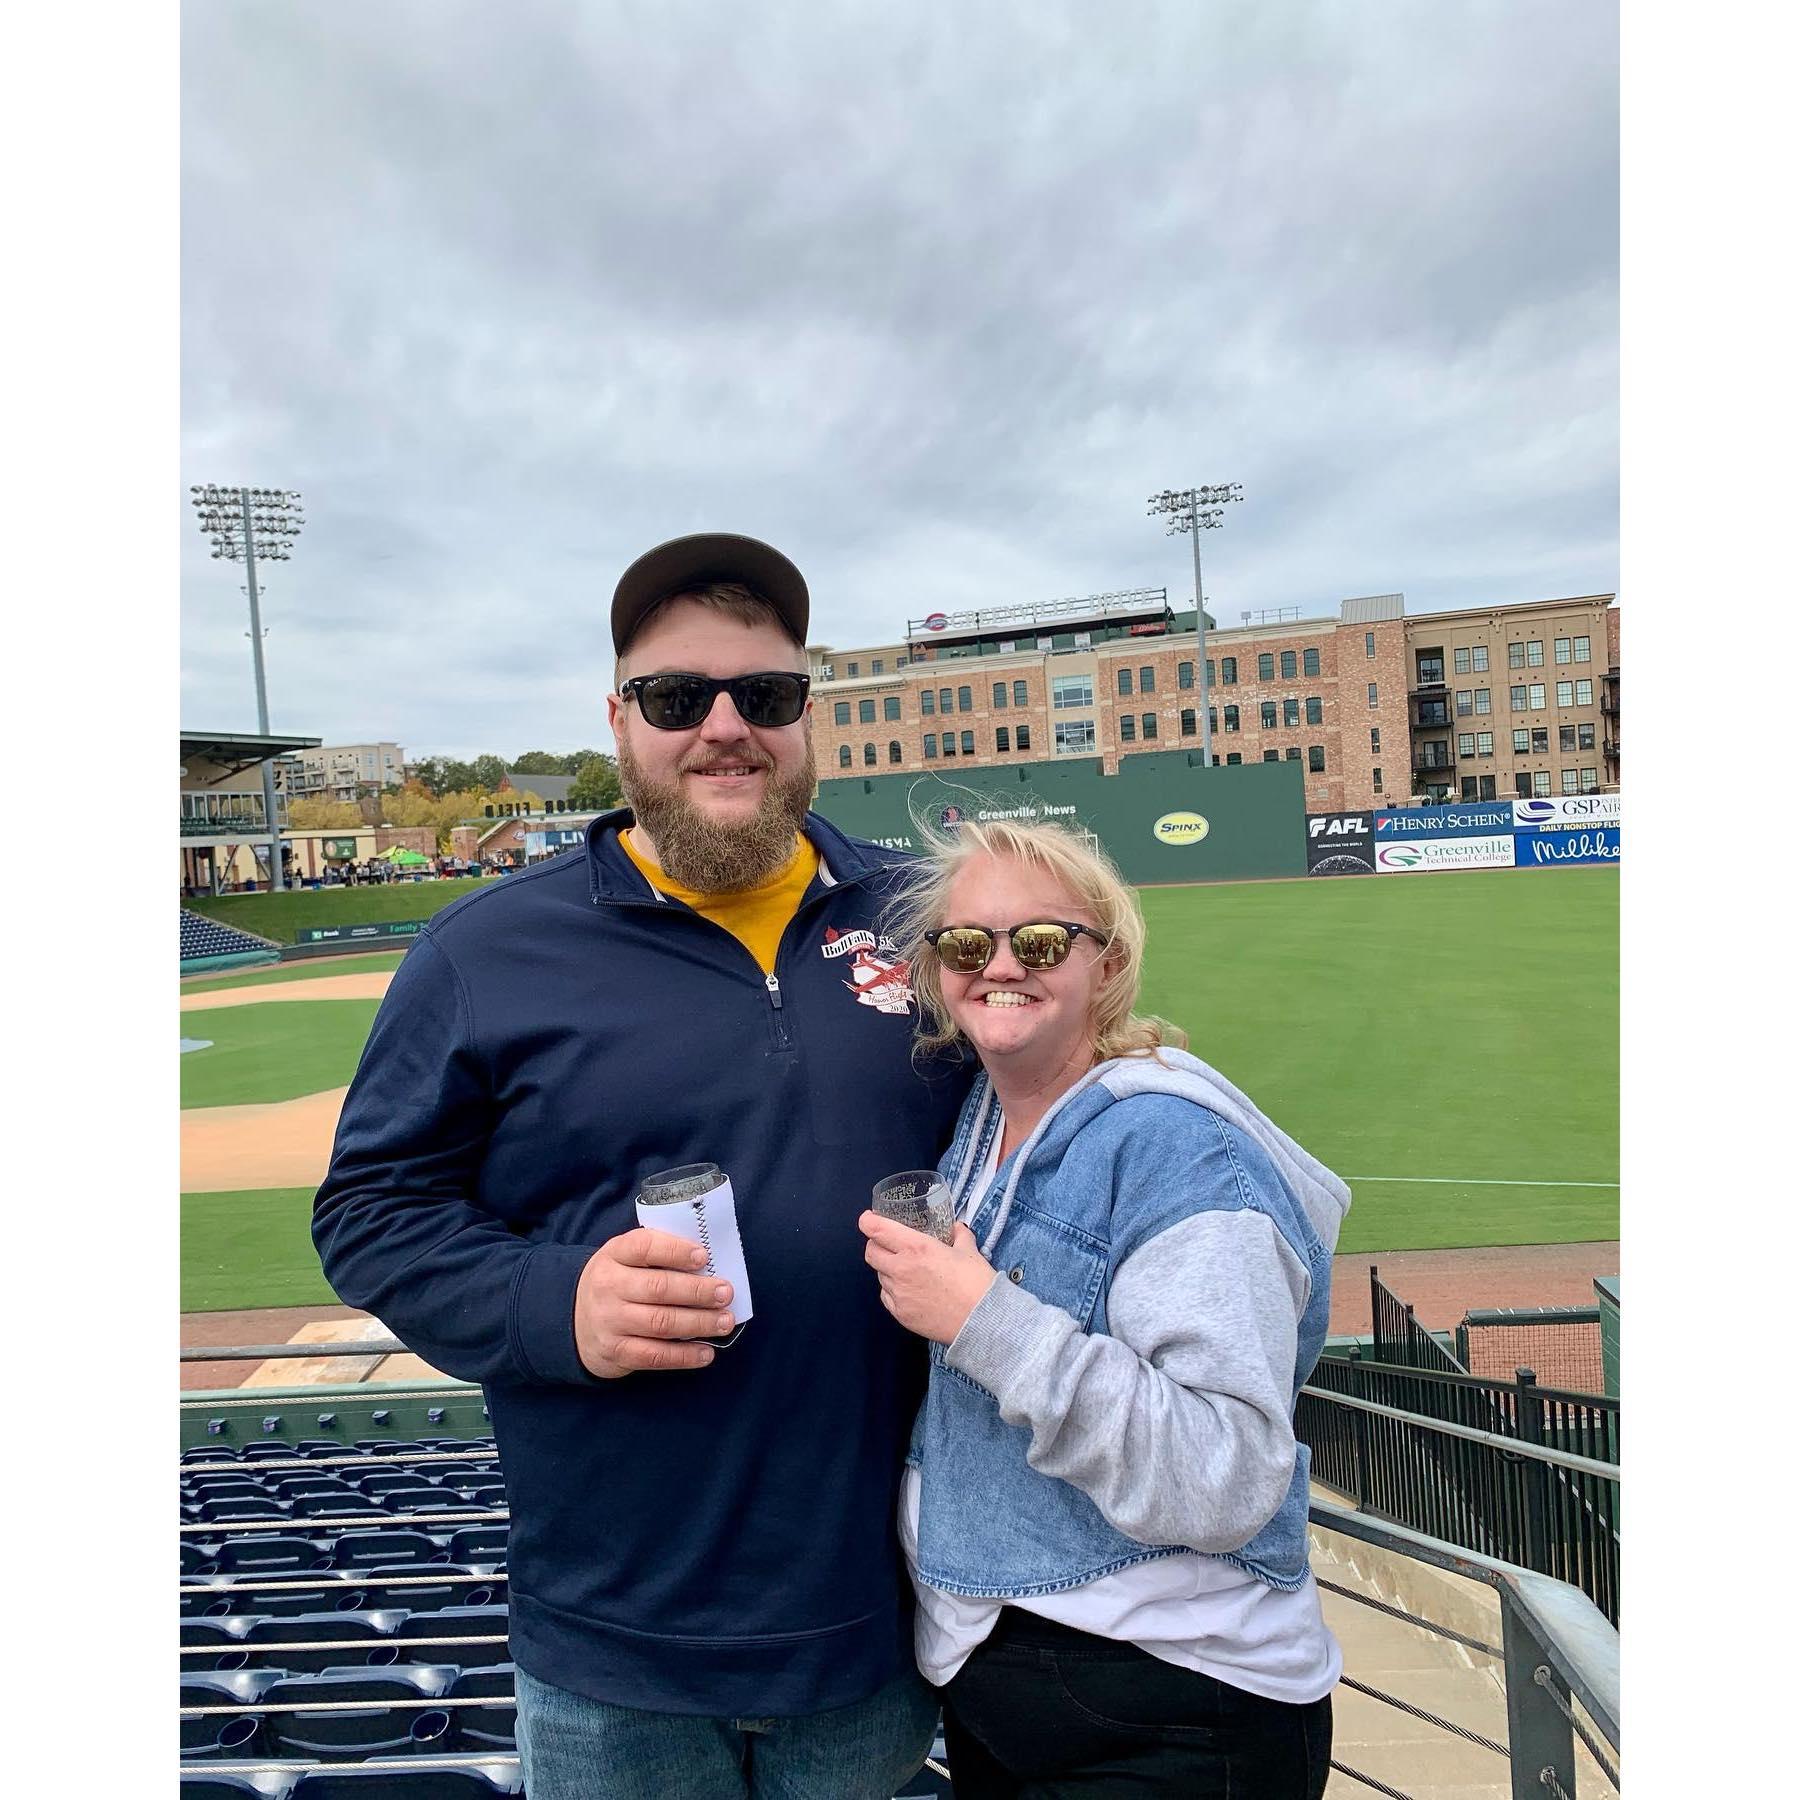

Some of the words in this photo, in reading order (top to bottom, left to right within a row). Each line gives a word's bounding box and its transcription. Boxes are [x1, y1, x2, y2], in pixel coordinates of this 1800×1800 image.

[978, 806, 1037, 820] Greenville
[1044, 805, 1076, 816] News
[1562, 799, 1601, 815] GSP
[1160, 823, 1202, 833] SPINX
[1392, 816, 1445, 831] HENRY
[1563, 822, 1602, 831] NONSTOP
[1424, 842, 1511, 857] Greenville
[1532, 832, 1620, 863] Millike
[1426, 855, 1470, 865] Technical
[1471, 853, 1511, 863] College
[390, 922, 418, 933] Family
[824, 939, 848, 957] Bull
[890, 1004, 908, 1013] 2020
